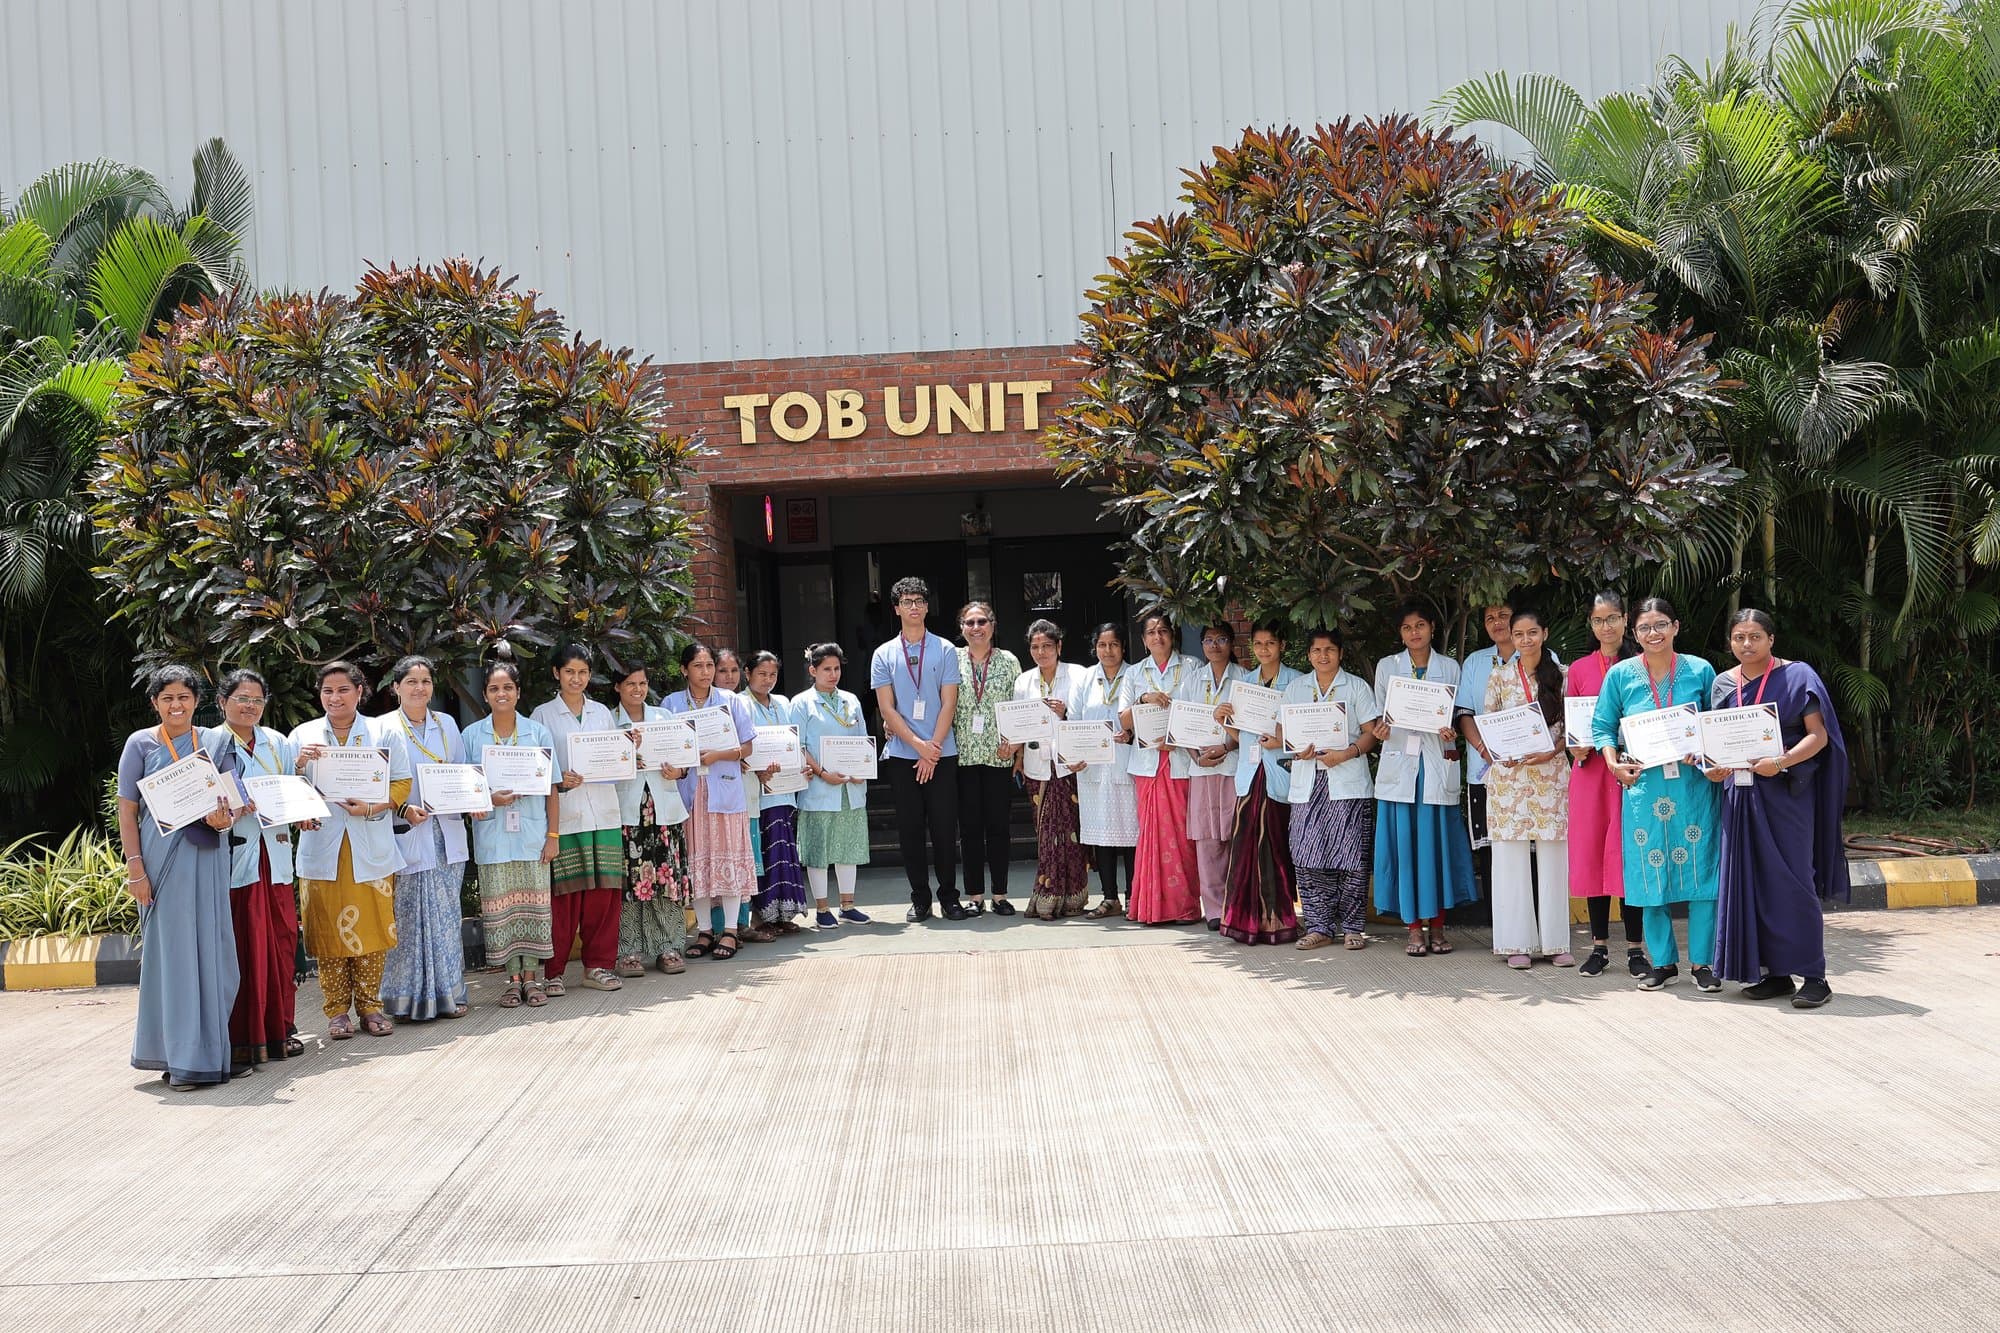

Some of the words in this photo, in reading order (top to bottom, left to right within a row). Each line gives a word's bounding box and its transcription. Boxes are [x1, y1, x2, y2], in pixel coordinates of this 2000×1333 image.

[723, 391, 867, 444] TOB
[884, 380, 1053, 436] UNIT
[1489, 711, 1527, 724] CERTIFICATE
[1714, 712, 1760, 722] CERTIFICATE
[646, 724, 684, 733] CERTIFICATE
[582, 735, 620, 743] CERTIFICATE
[156, 761, 197, 786] CERTIFICATE
